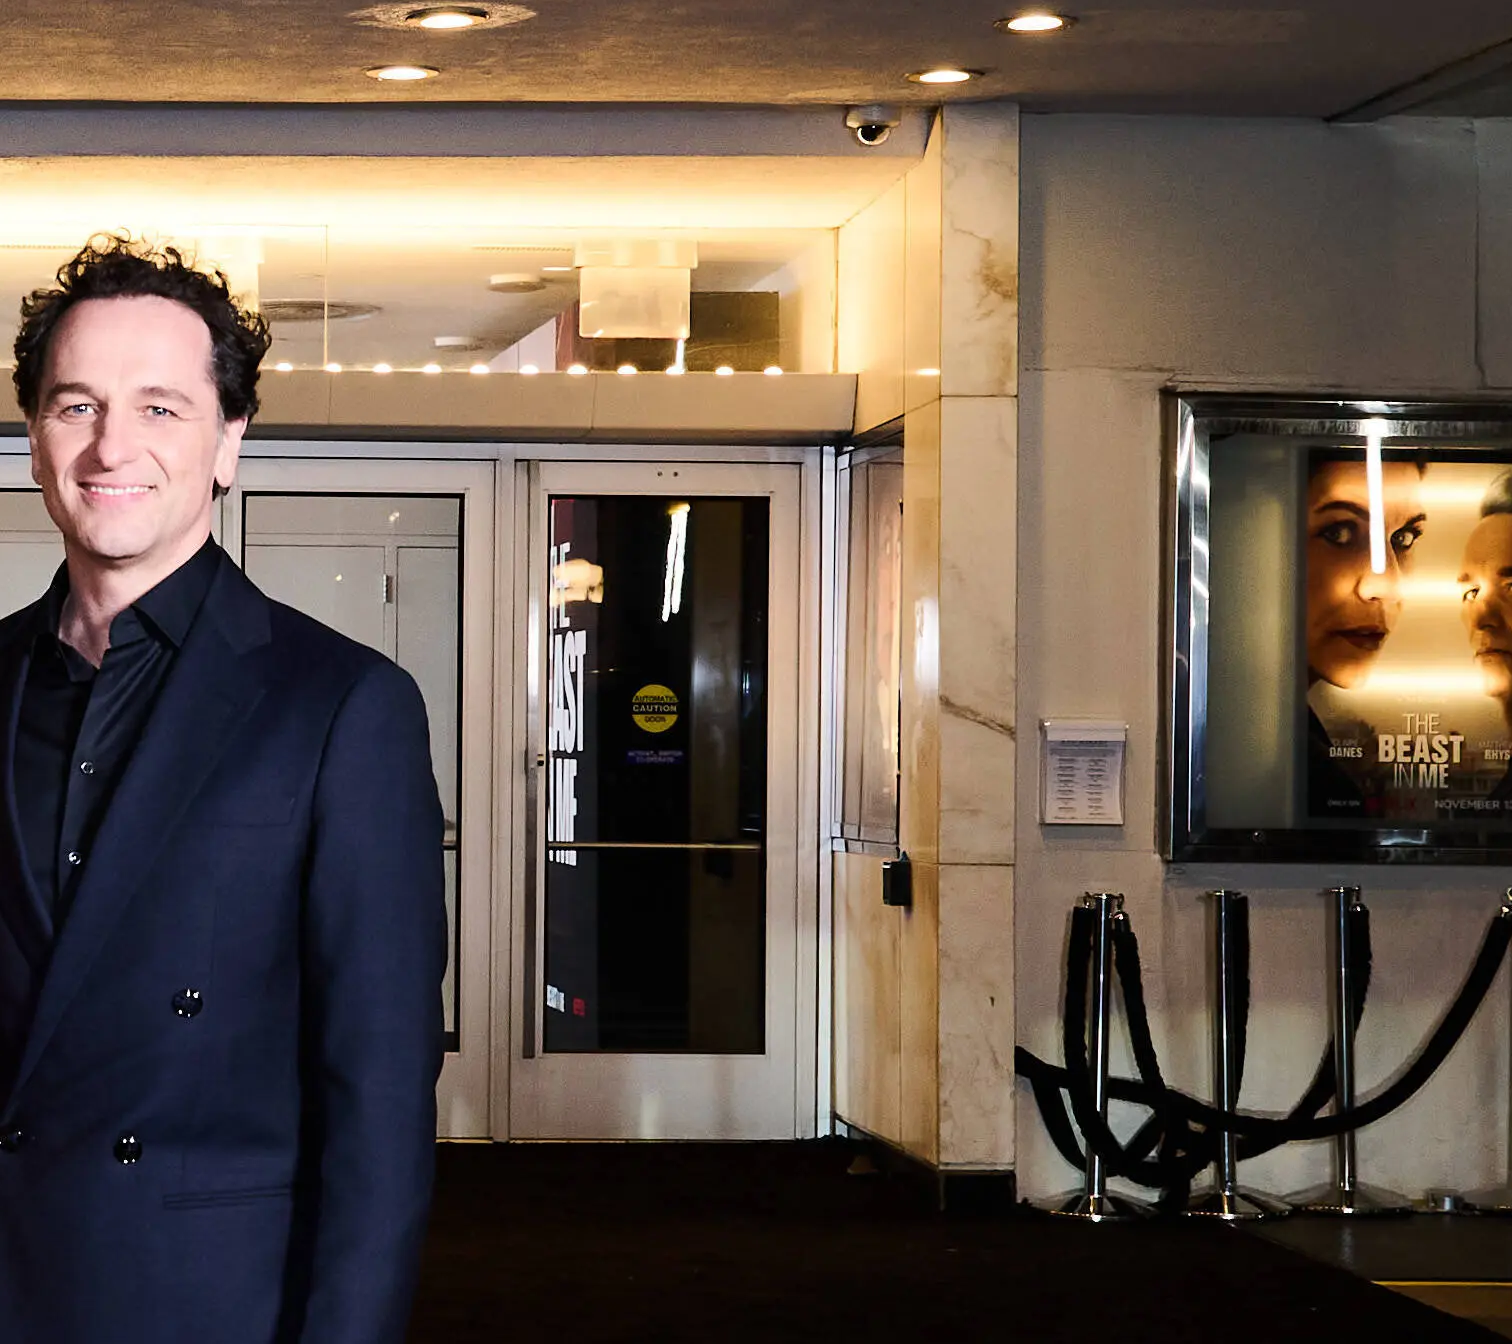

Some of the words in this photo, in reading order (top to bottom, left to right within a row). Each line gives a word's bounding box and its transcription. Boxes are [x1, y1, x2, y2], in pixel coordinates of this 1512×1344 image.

[632, 703, 678, 713] CAUTION
[1402, 712, 1441, 735] THE
[1329, 746, 1364, 759] DANES
[1378, 733, 1465, 764] BEAST
[1483, 749, 1512, 761] RHYS
[1393, 763, 1415, 789] IN
[1418, 763, 1449, 789] ME
[1434, 799, 1500, 811] NOVEMBER
